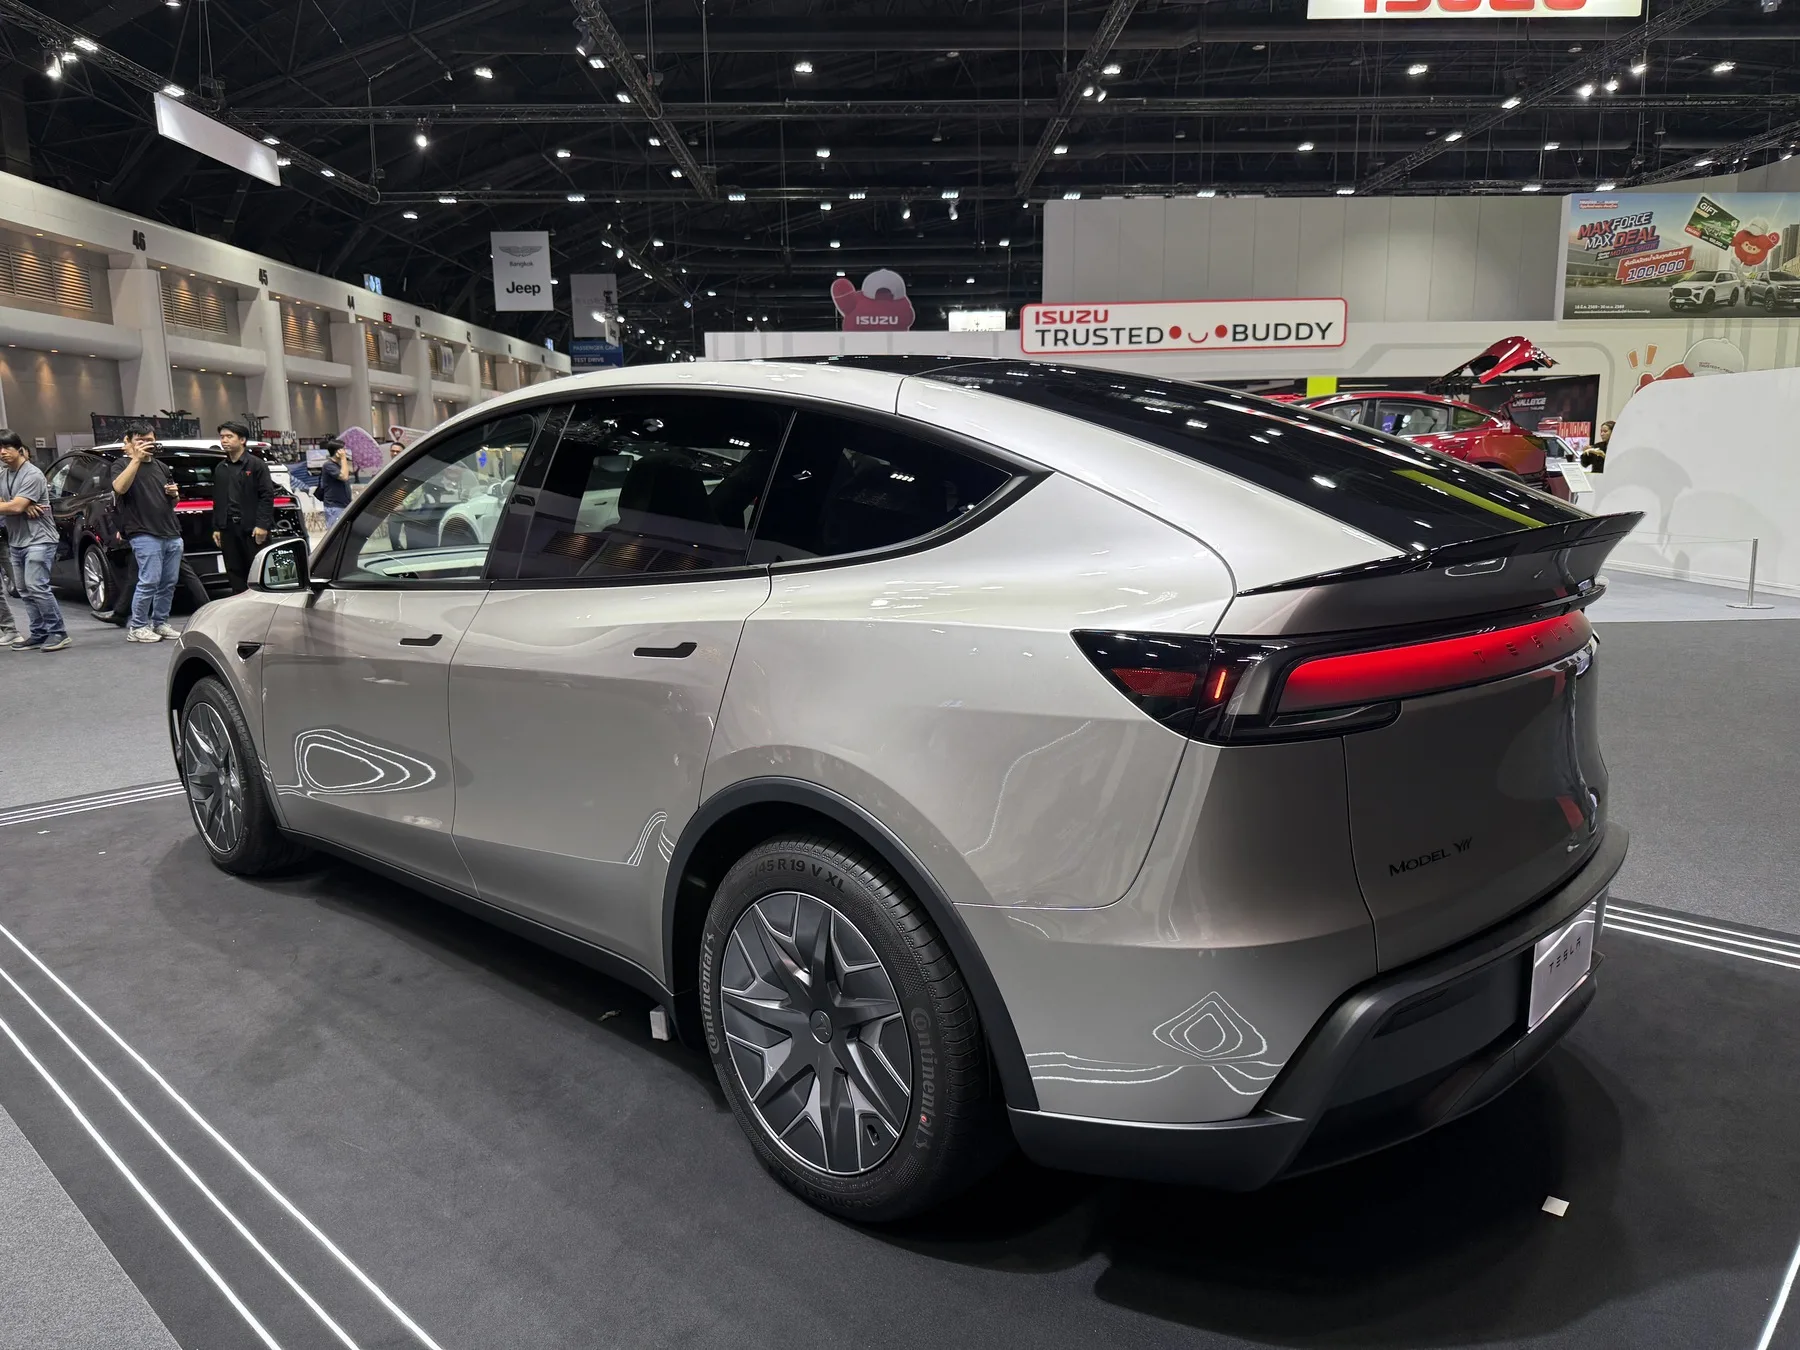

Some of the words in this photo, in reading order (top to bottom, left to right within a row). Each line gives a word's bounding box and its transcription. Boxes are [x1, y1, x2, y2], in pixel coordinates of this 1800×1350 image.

[1700, 202, 1718, 216] GIFT
[132, 229, 146, 251] 46
[1584, 232, 1614, 251] MAX
[1613, 226, 1659, 249] DEAL
[1610, 247, 1634, 257] MOTOR
[1636, 242, 1658, 253] SHOW
[258, 268, 269, 286] 45
[1627, 259, 1686, 281] 100,000
[506, 281, 541, 296] Jeep
[856, 316, 898, 325] ISUZU
[1035, 309, 1109, 325] ISUZU
[1035, 326, 1164, 347] TRUSTED
[1232, 321, 1334, 342] BUDDY
[1473, 621, 1575, 663] TESLA
[1388, 848, 1451, 877] MODEL
[777, 859, 787, 871] R
[791, 859, 806, 872] 19
[811, 864, 822, 877] V
[825, 871, 845, 894] XL
[1549, 936, 1581, 974] TESLA
[702, 944, 720, 1054] Continental
[911, 1008, 938, 1138] Continental
